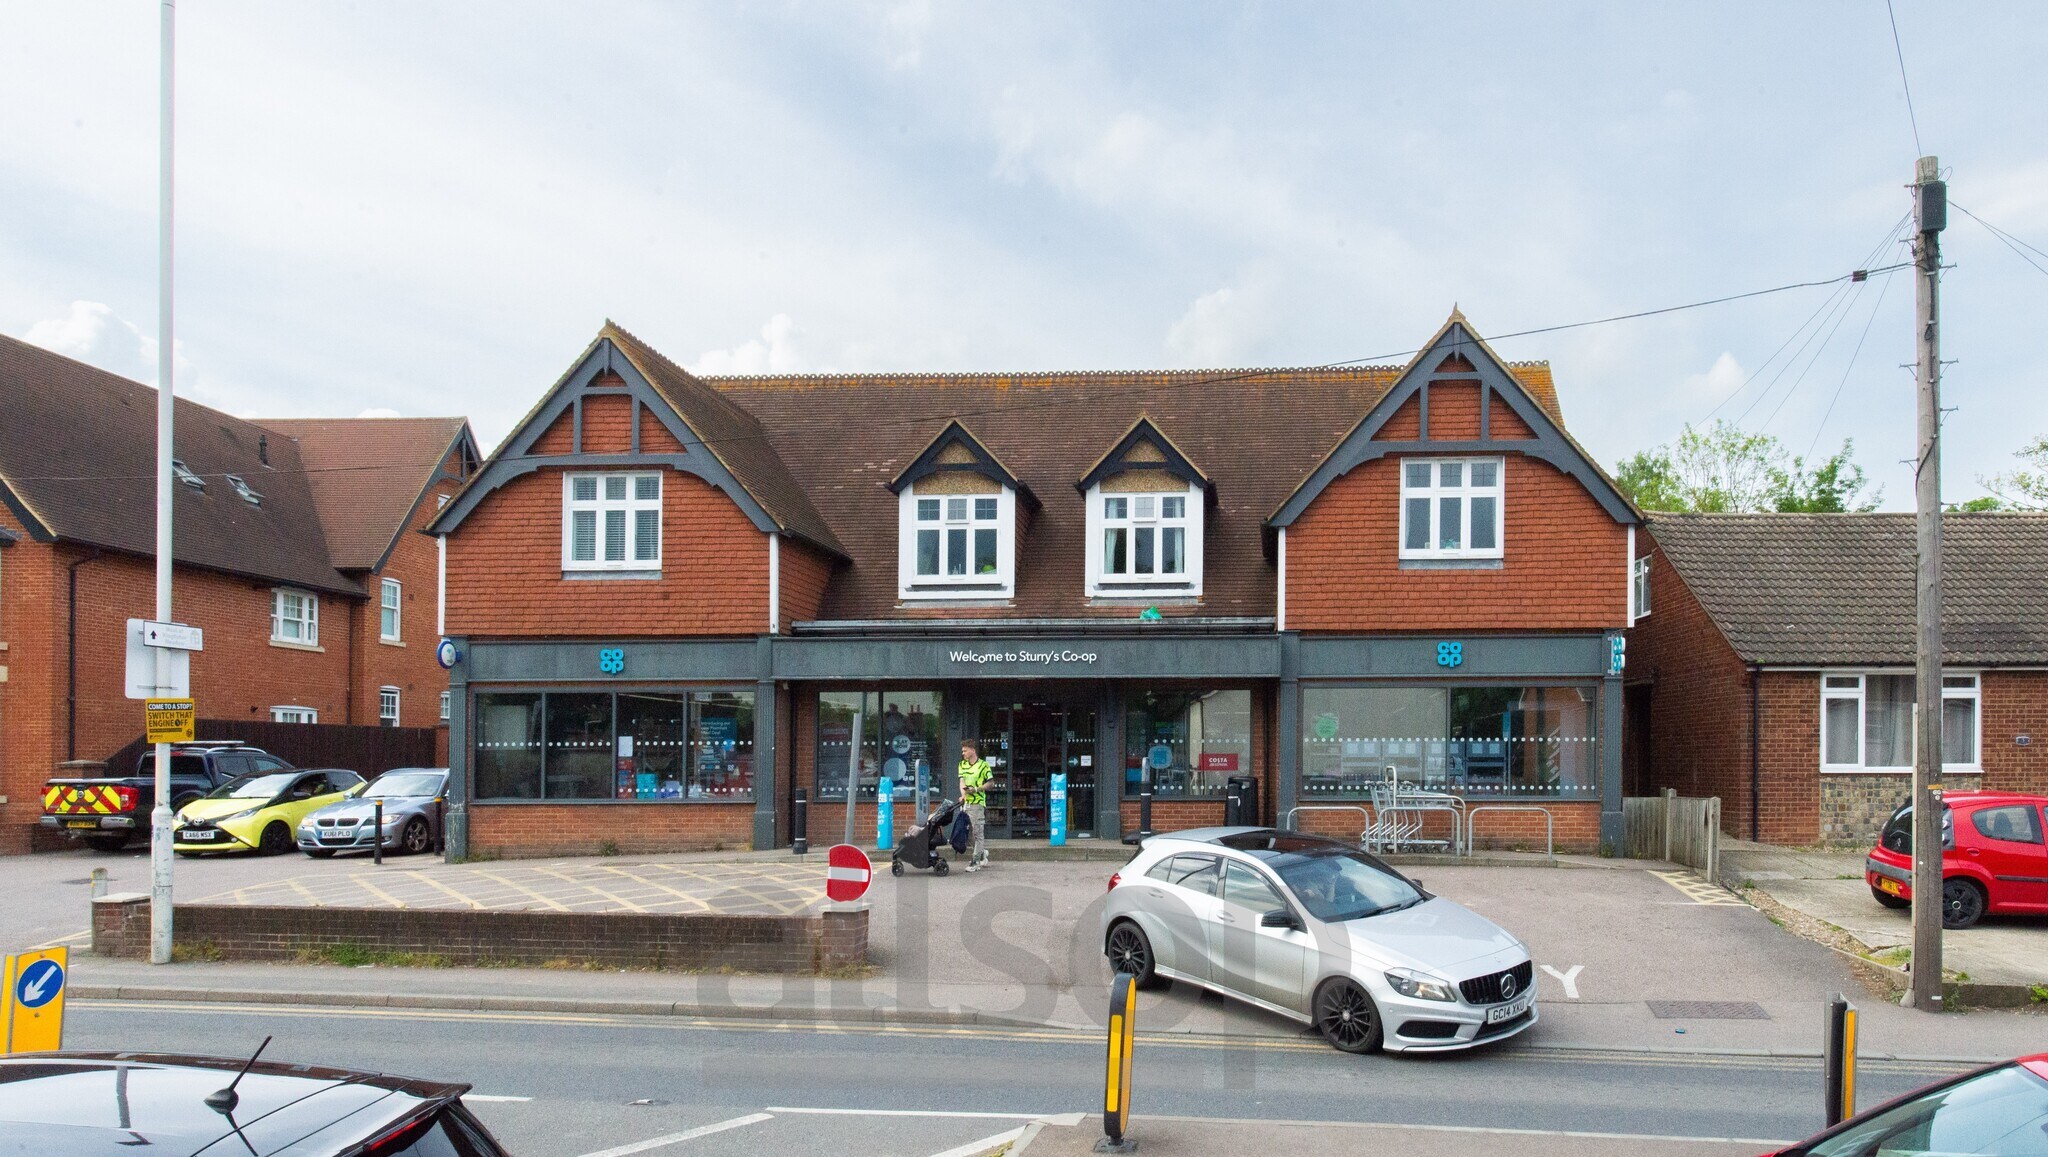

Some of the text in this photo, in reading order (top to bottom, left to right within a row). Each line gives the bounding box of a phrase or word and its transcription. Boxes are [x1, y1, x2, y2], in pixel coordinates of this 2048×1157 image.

[949, 650, 1097, 664] Welcome to Sturry's Co-op
[148, 711, 193, 719] SWITCH THAT
[148, 719, 188, 727] ENGINE OFF
[1492, 1007, 1511, 1021] GC14
